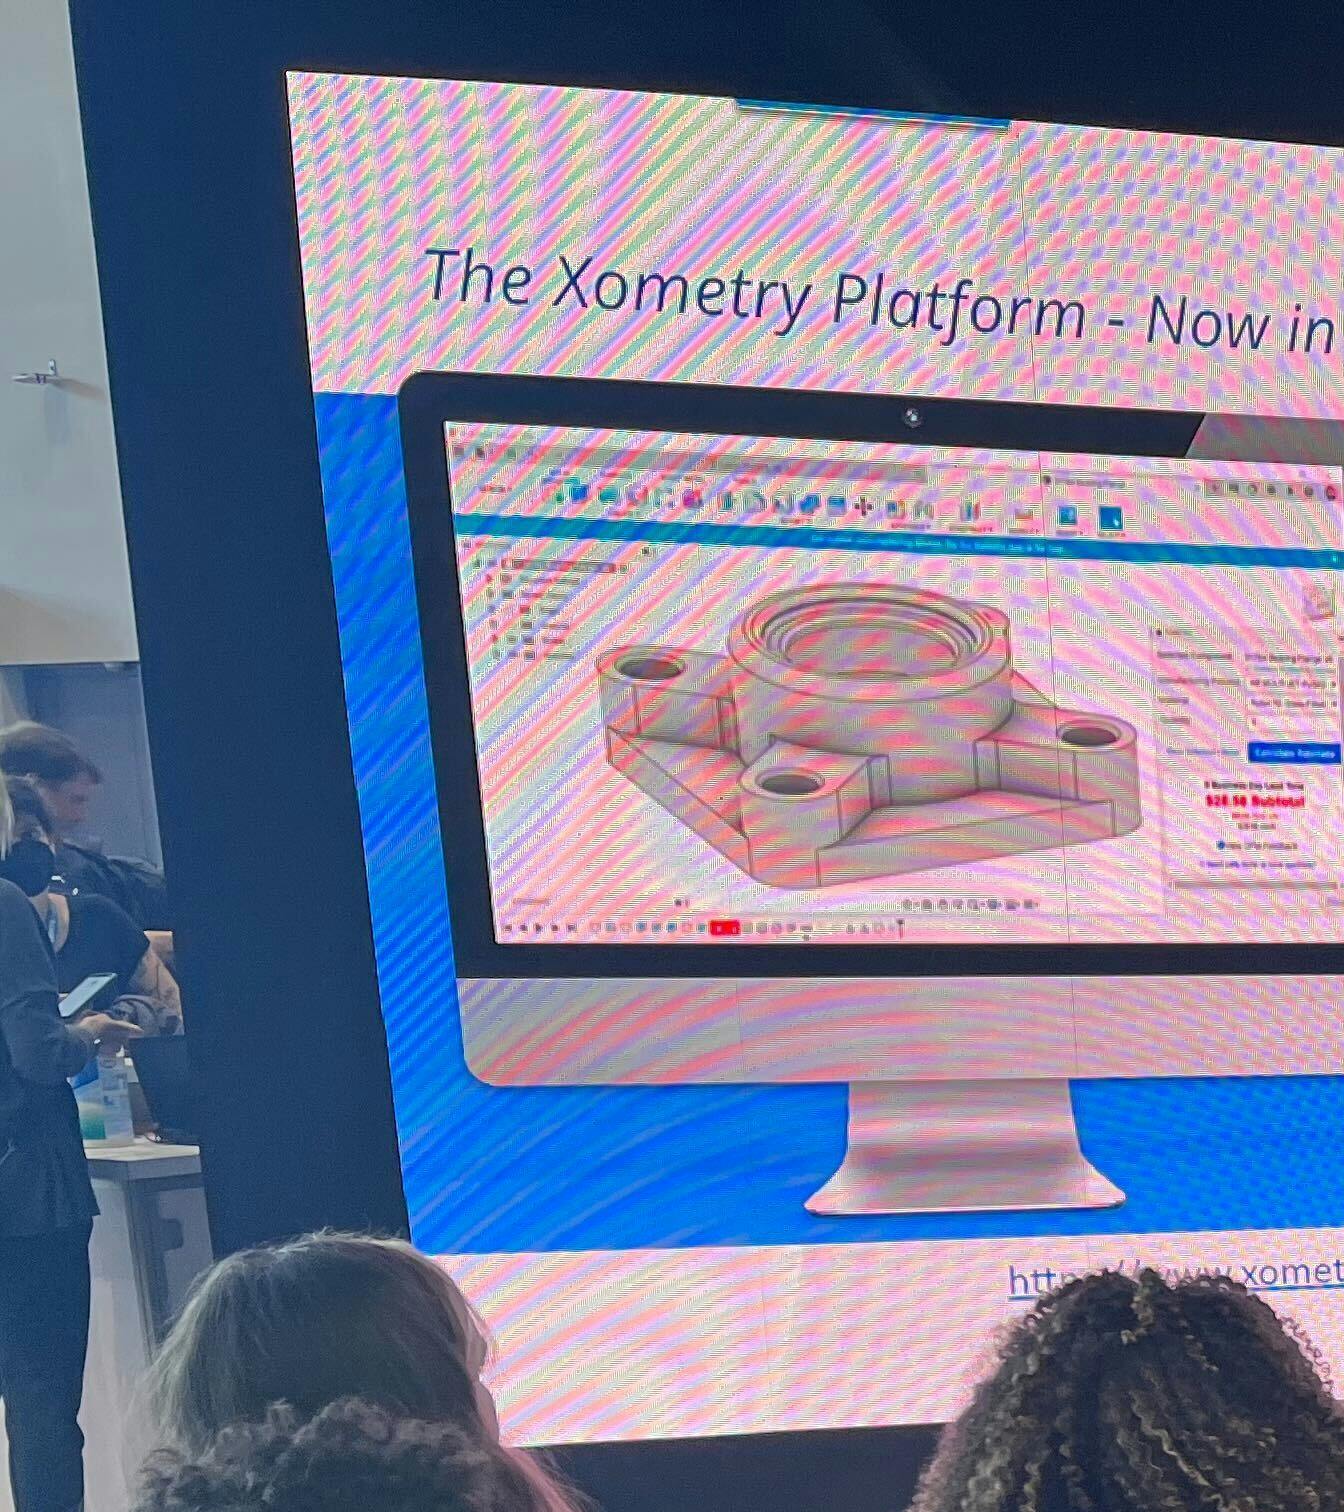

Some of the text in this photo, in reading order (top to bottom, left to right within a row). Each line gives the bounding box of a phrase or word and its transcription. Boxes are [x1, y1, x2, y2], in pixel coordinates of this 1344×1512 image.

[425, 246, 531, 306] The
[553, 255, 812, 337] Xometry
[832, 271, 1086, 346] Platform
[1147, 294, 1270, 350] Now
[1288, 303, 1335, 355] in
